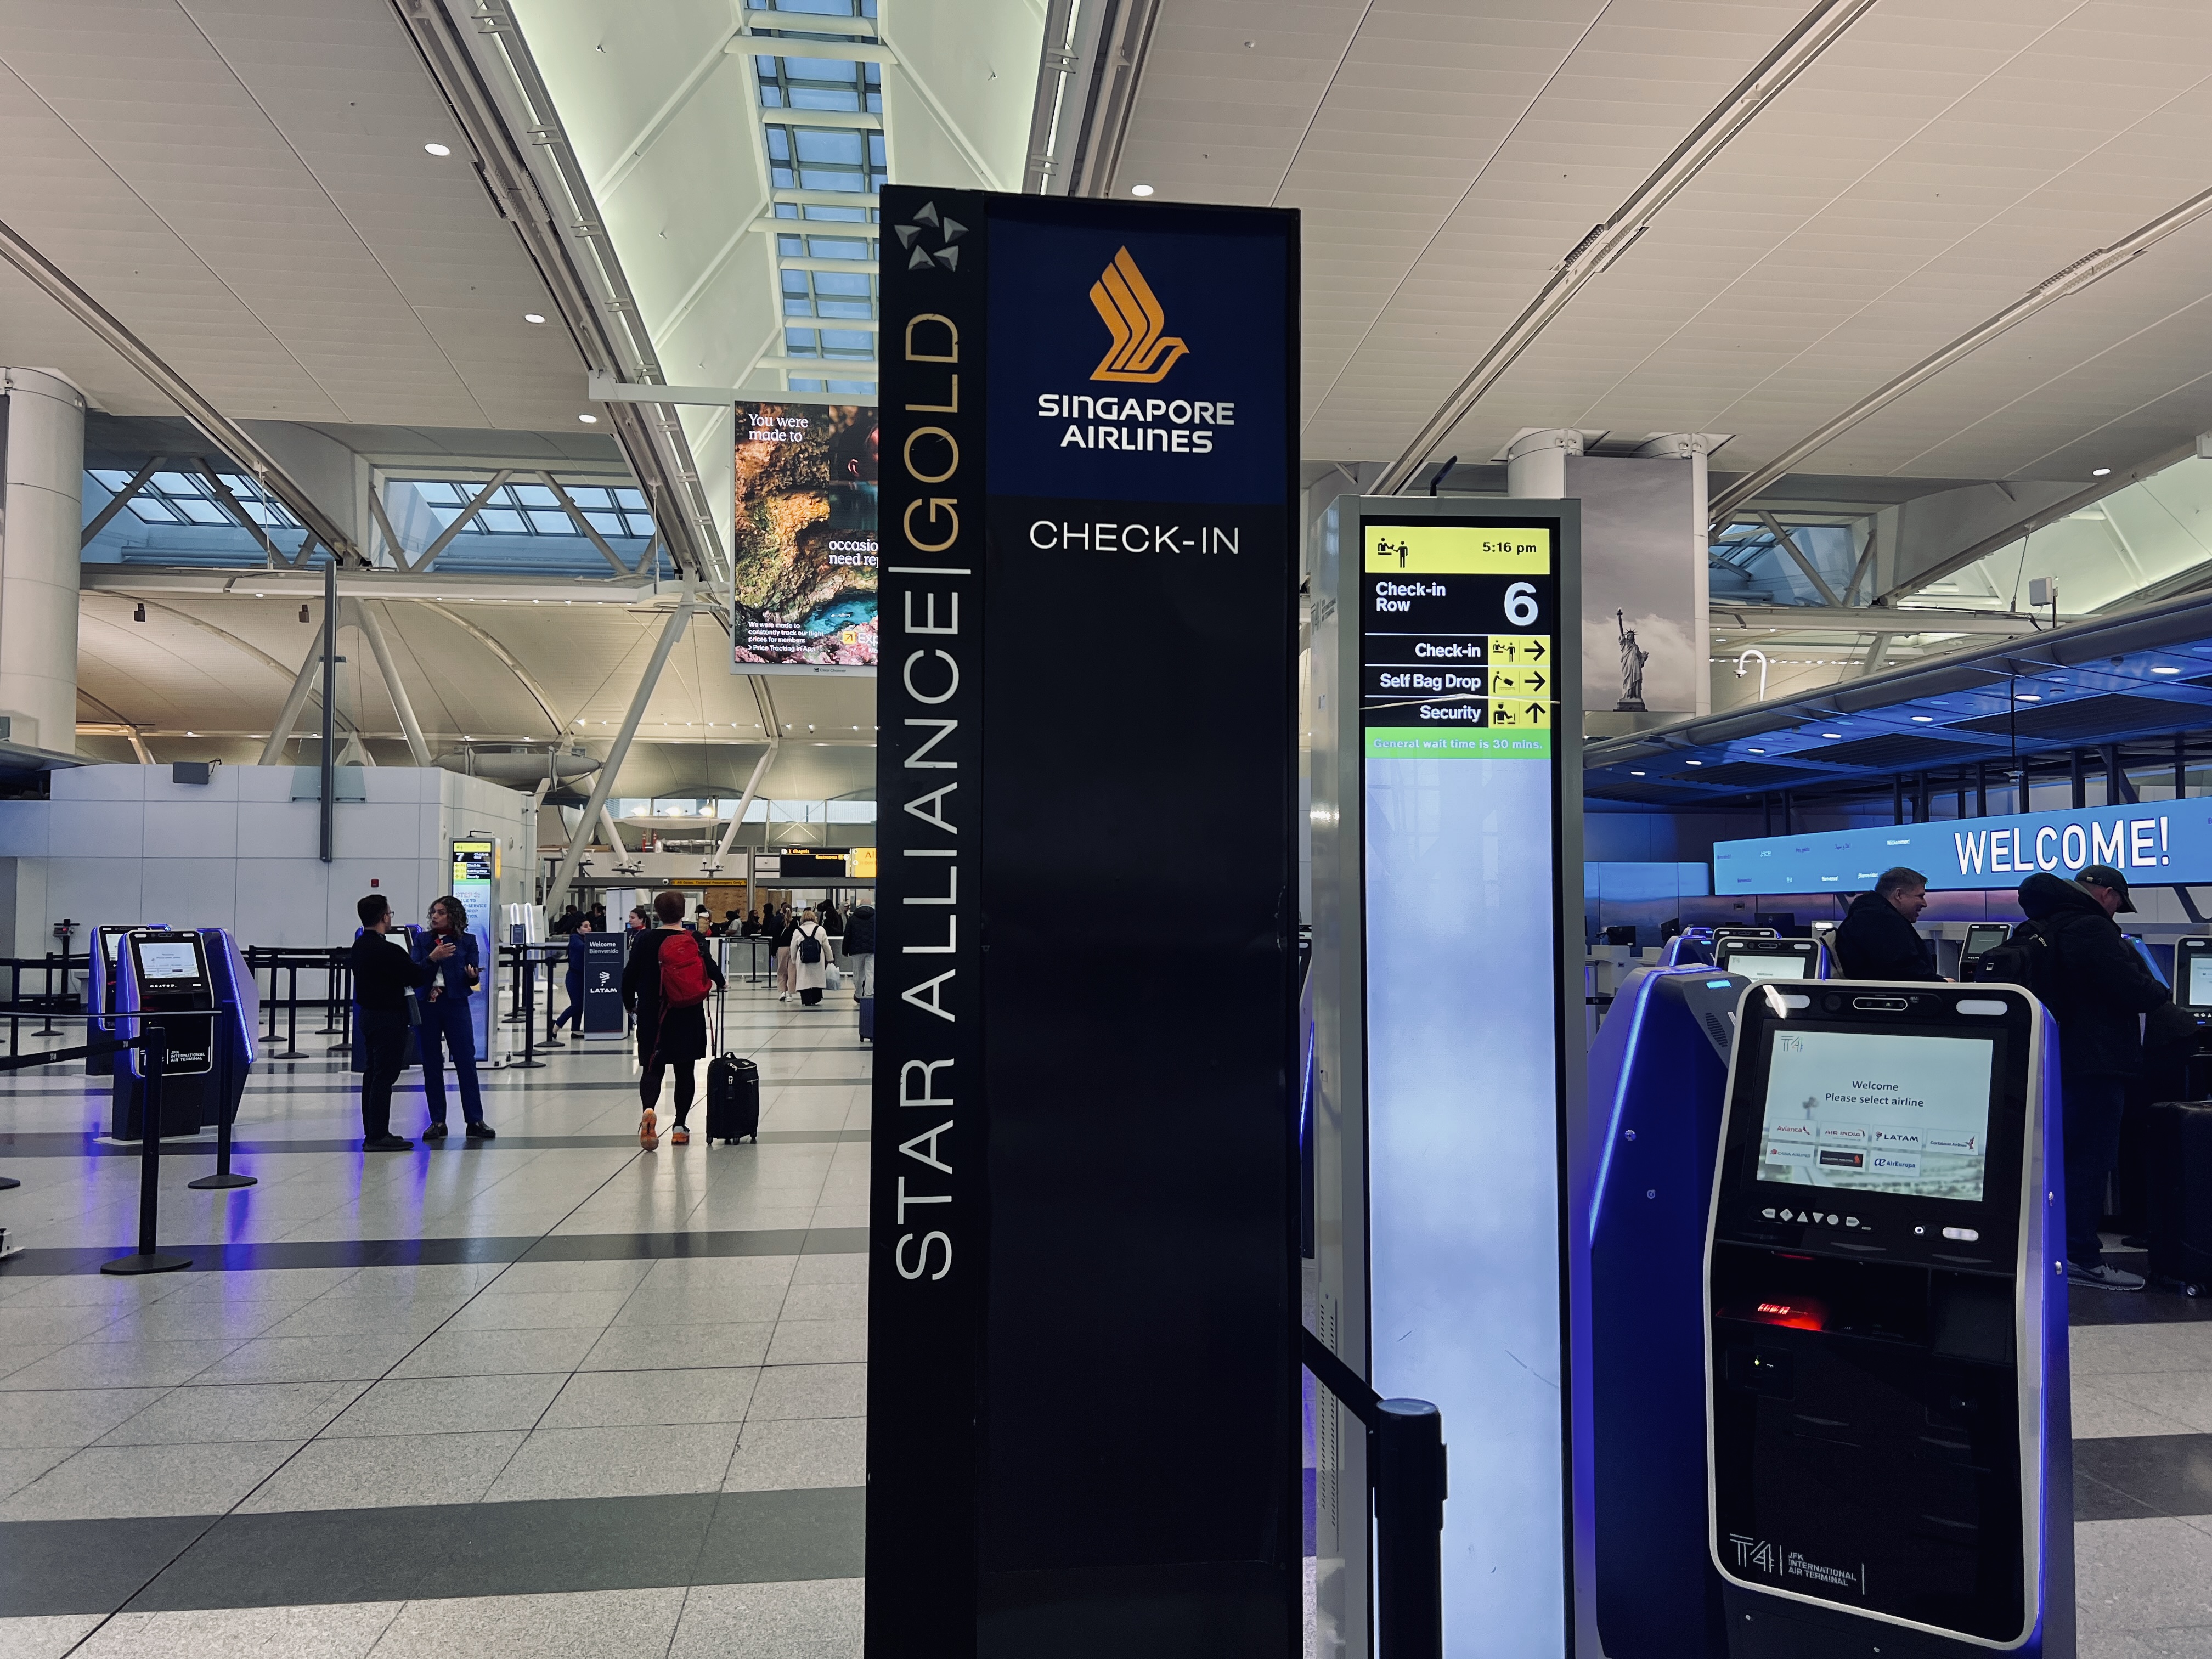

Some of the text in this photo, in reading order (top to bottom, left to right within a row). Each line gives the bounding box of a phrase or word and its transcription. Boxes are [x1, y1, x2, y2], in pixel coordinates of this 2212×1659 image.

[1039, 394, 1234, 425] SINGAPORE
[748, 413, 809, 428] You were
[748, 428, 803, 442] made to
[1060, 425, 1212, 453] AIRLINES
[1030, 520, 1238, 554] CHECK-IN
[1482, 541, 1537, 555] 5:16 pm
[828, 552, 861, 566] need
[1376, 582, 1446, 596] Check-in
[1376, 597, 1410, 612] Row
[1504, 582, 1538, 626] 6
[1415, 642, 1481, 658] Check-in
[1380, 673, 1481, 691] Self Bag Drop
[1420, 704, 1481, 722] Security
[1374, 738, 1543, 749] General wait time is 30 mins.
[896, 313, 959, 1280] STAR ALLIANCE GOLD
[1954, 816, 2170, 875] WELCOME!
[456, 852, 464, 861] 7
[1781, 1035, 1804, 1053] T4
[1852, 1080, 1899, 1091] Welcome
[1825, 1092, 1924, 1107] Please select airline
[1884, 1133, 1918, 1142] LATAM
[1729, 1533, 1775, 1573] T4
[1788, 1551, 1804, 1561] JFK
[1788, 1558, 1857, 1582] INTERNATIONAL
[1788, 1566, 1849, 1587] AIR TERMINAL
